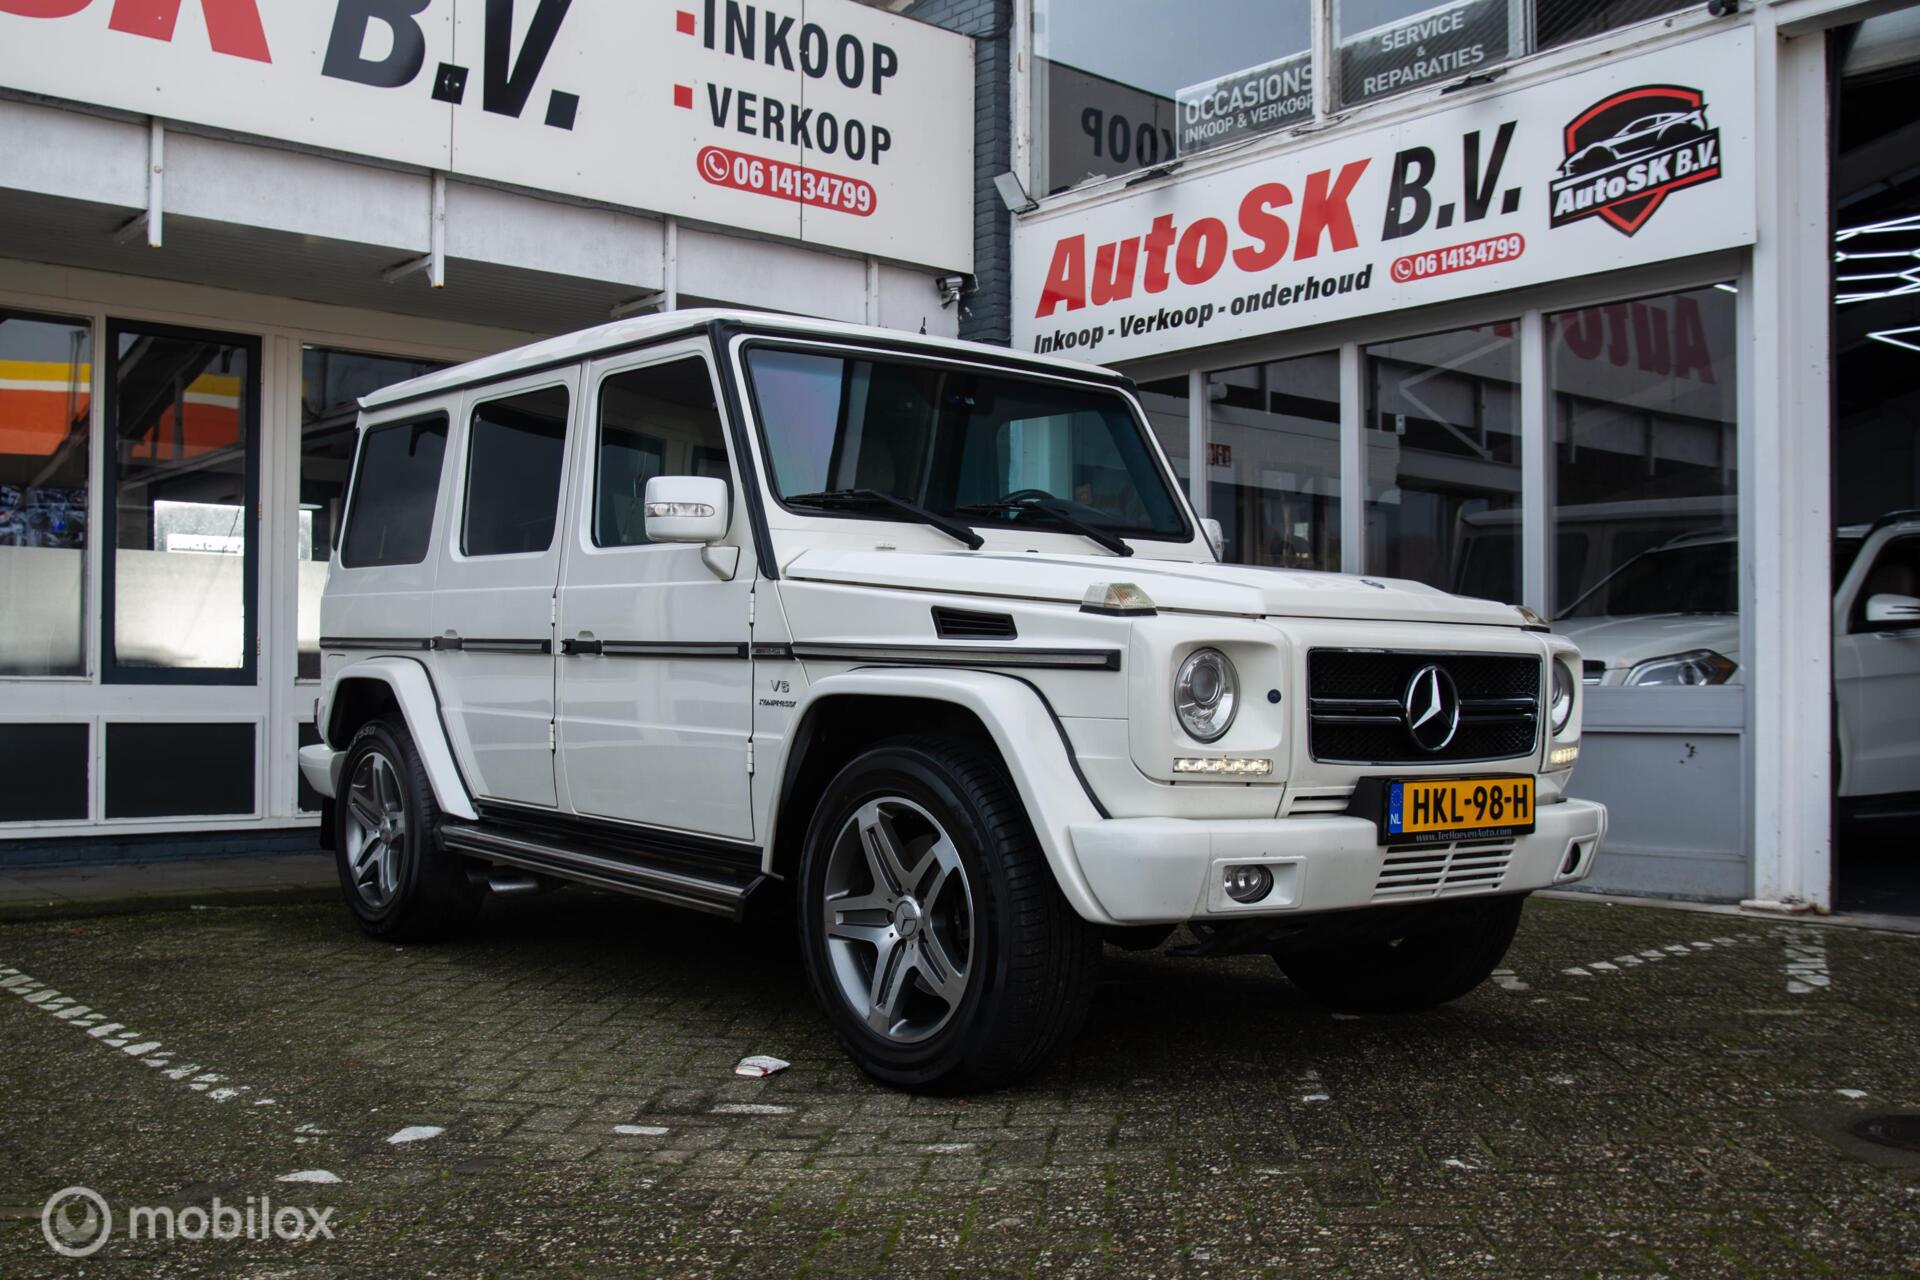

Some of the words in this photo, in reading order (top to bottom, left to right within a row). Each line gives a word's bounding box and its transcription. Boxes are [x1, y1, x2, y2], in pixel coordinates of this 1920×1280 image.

[703, 0, 898, 96] INKOOP
[1381, 11, 1464, 52] SERVICE
[1416, 46, 1426, 57] &
[1185, 64, 1313, 125] OCCASIONS
[1363, 44, 1485, 96] REPARATIES
[707, 82, 892, 166] VERKOOP
[1185, 116, 1233, 144] INKOOP
[1236, 112, 1248, 129] &
[1251, 93, 1313, 125] VERKOOP
[733, 157, 765, 189] 06
[769, 165, 871, 212] 14134799
[1552, 153, 1672, 218] AutoSK
[1674, 139, 1719, 176] B.V.
[1035, 157, 1373, 319] AutoSK
[1381, 120, 1522, 242] B.V.
[1414, 255, 1437, 276] 06
[1440, 235, 1520, 271] 14134799
[1034, 324, 1104, 355] Inkoop
[1120, 306, 1213, 339] Verkoop
[1230, 263, 1374, 316] onderhoud
[1390, 813, 1402, 825] NL
[1412, 784, 1529, 825] HKL-98-H
